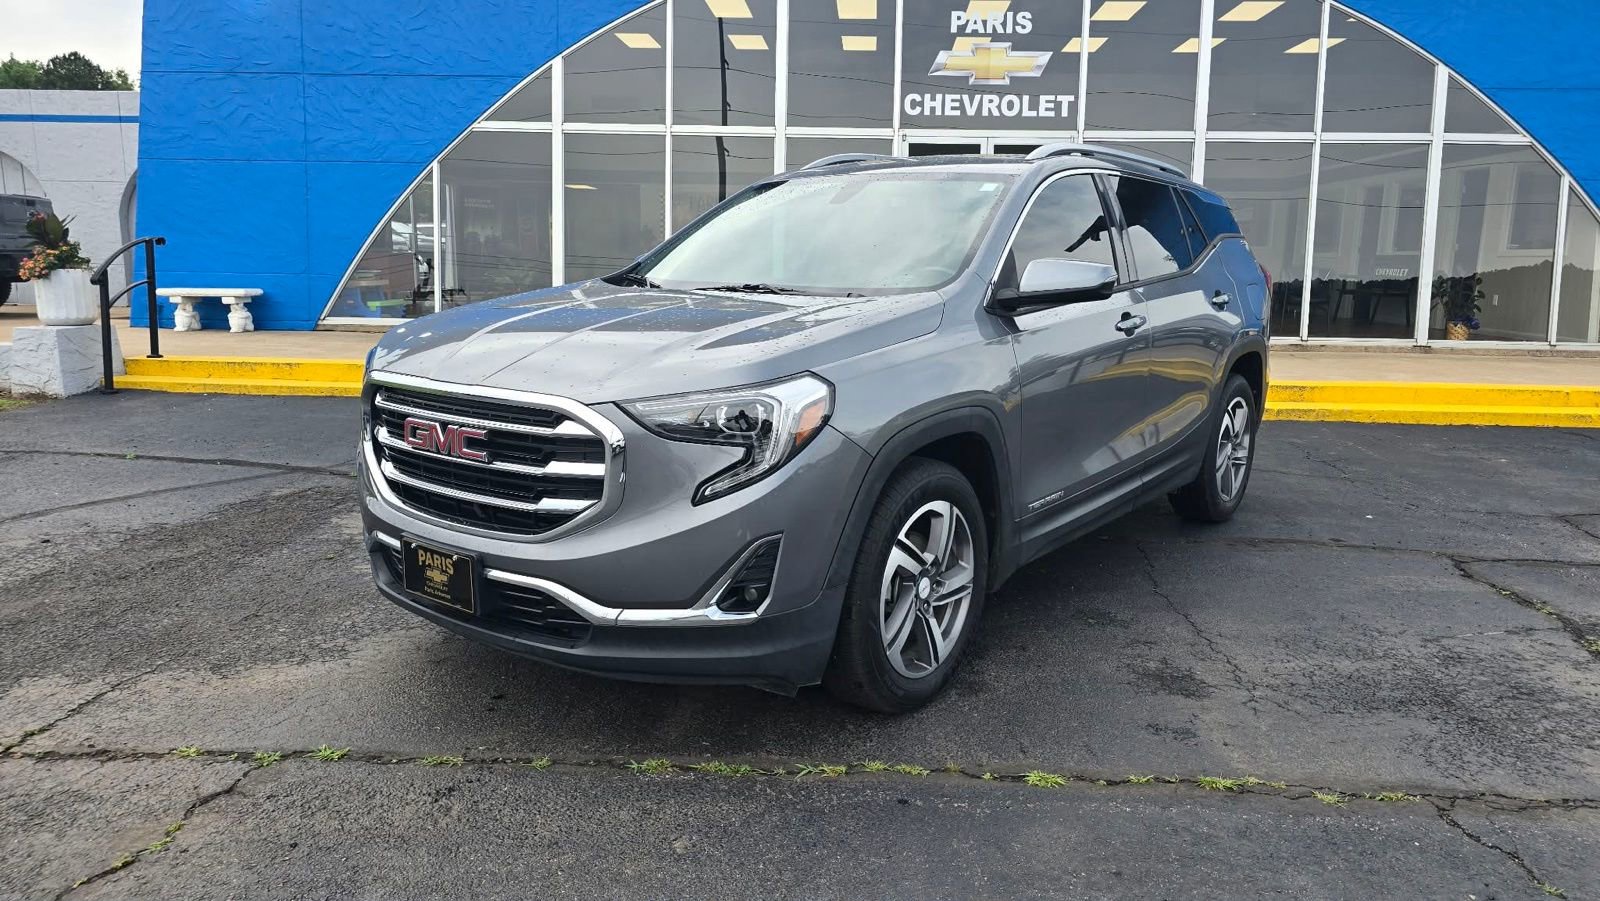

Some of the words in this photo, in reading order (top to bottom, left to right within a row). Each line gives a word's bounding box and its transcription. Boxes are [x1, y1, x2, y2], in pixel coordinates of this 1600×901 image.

[950, 11, 1033, 34] PARIS
[904, 93, 1075, 117] CHEVROLET
[404, 417, 488, 462] GMC
[417, 549, 454, 575] PARIS
